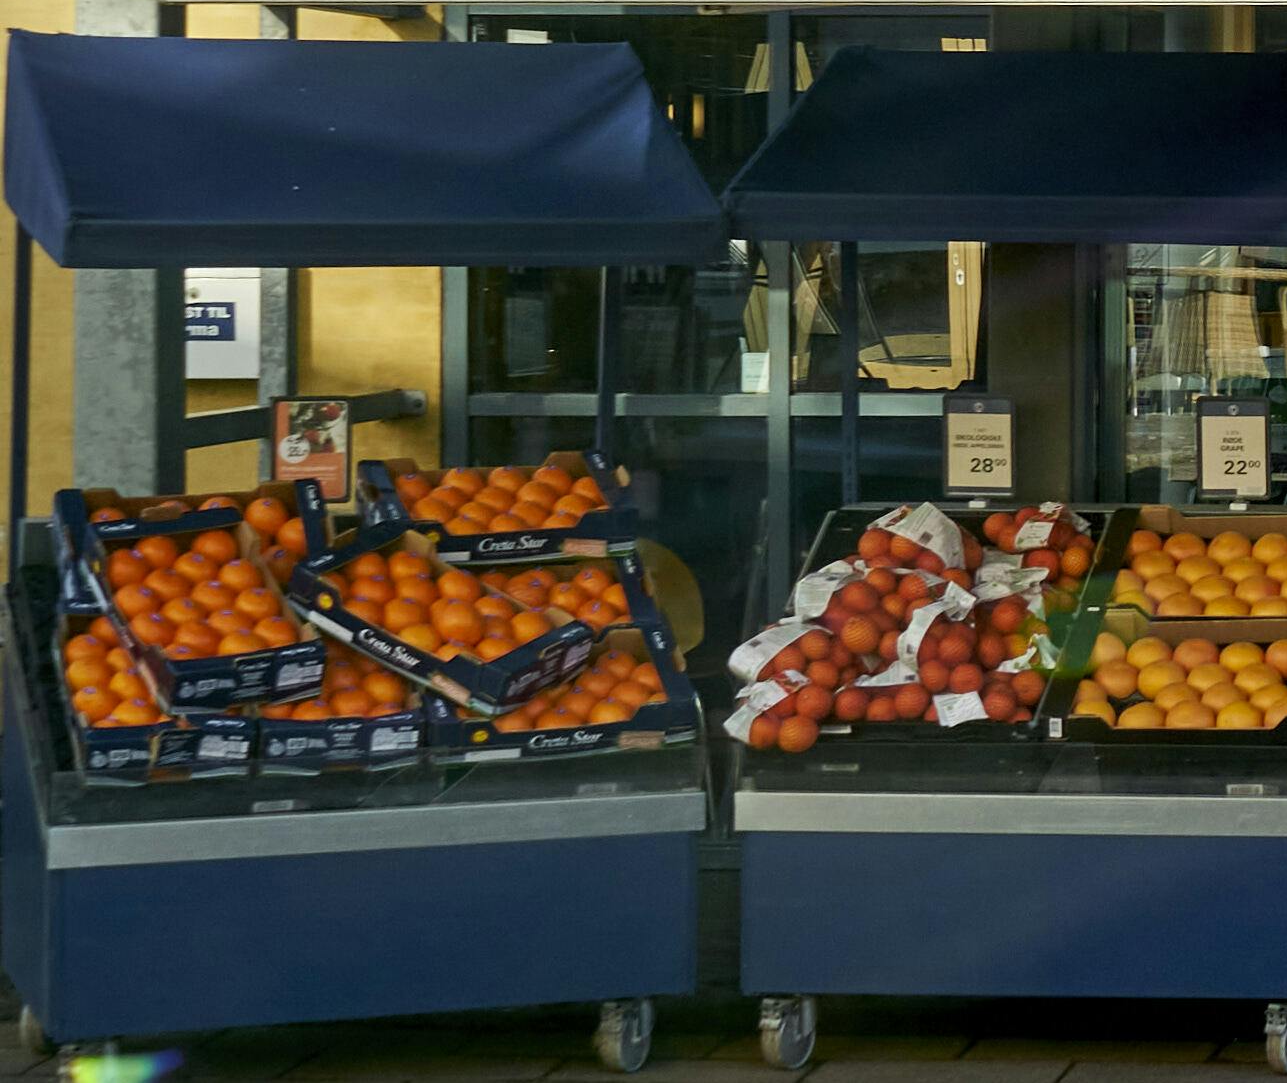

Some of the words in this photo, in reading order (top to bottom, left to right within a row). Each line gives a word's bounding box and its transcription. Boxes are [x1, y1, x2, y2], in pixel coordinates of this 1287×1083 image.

[185, 306, 204, 319] ST
[207, 306, 232, 319] TIL
[185, 324, 220, 337] rma
[479, 537, 516, 552] Creta
[517, 535, 549, 550] Star
[359, 628, 392, 654] Creta
[391, 645, 421, 666] Star
[529, 734, 569, 749] Creta
[570, 730, 603, 746] Star
